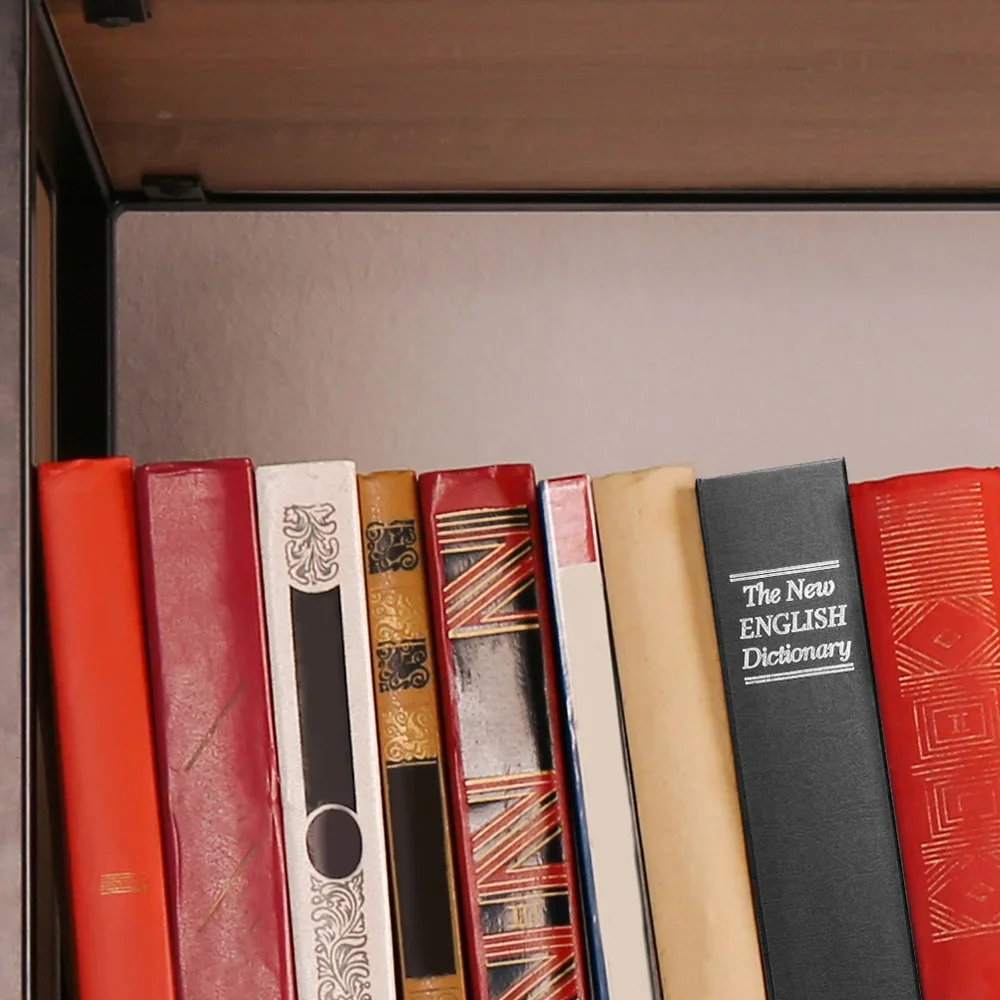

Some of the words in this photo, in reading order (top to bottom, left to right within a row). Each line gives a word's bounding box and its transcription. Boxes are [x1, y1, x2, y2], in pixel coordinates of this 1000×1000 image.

[743, 582, 781, 607] The
[786, 579, 835, 601] New
[740, 604, 847, 639] ENGLISH
[742, 640, 852, 669] Dictionary
